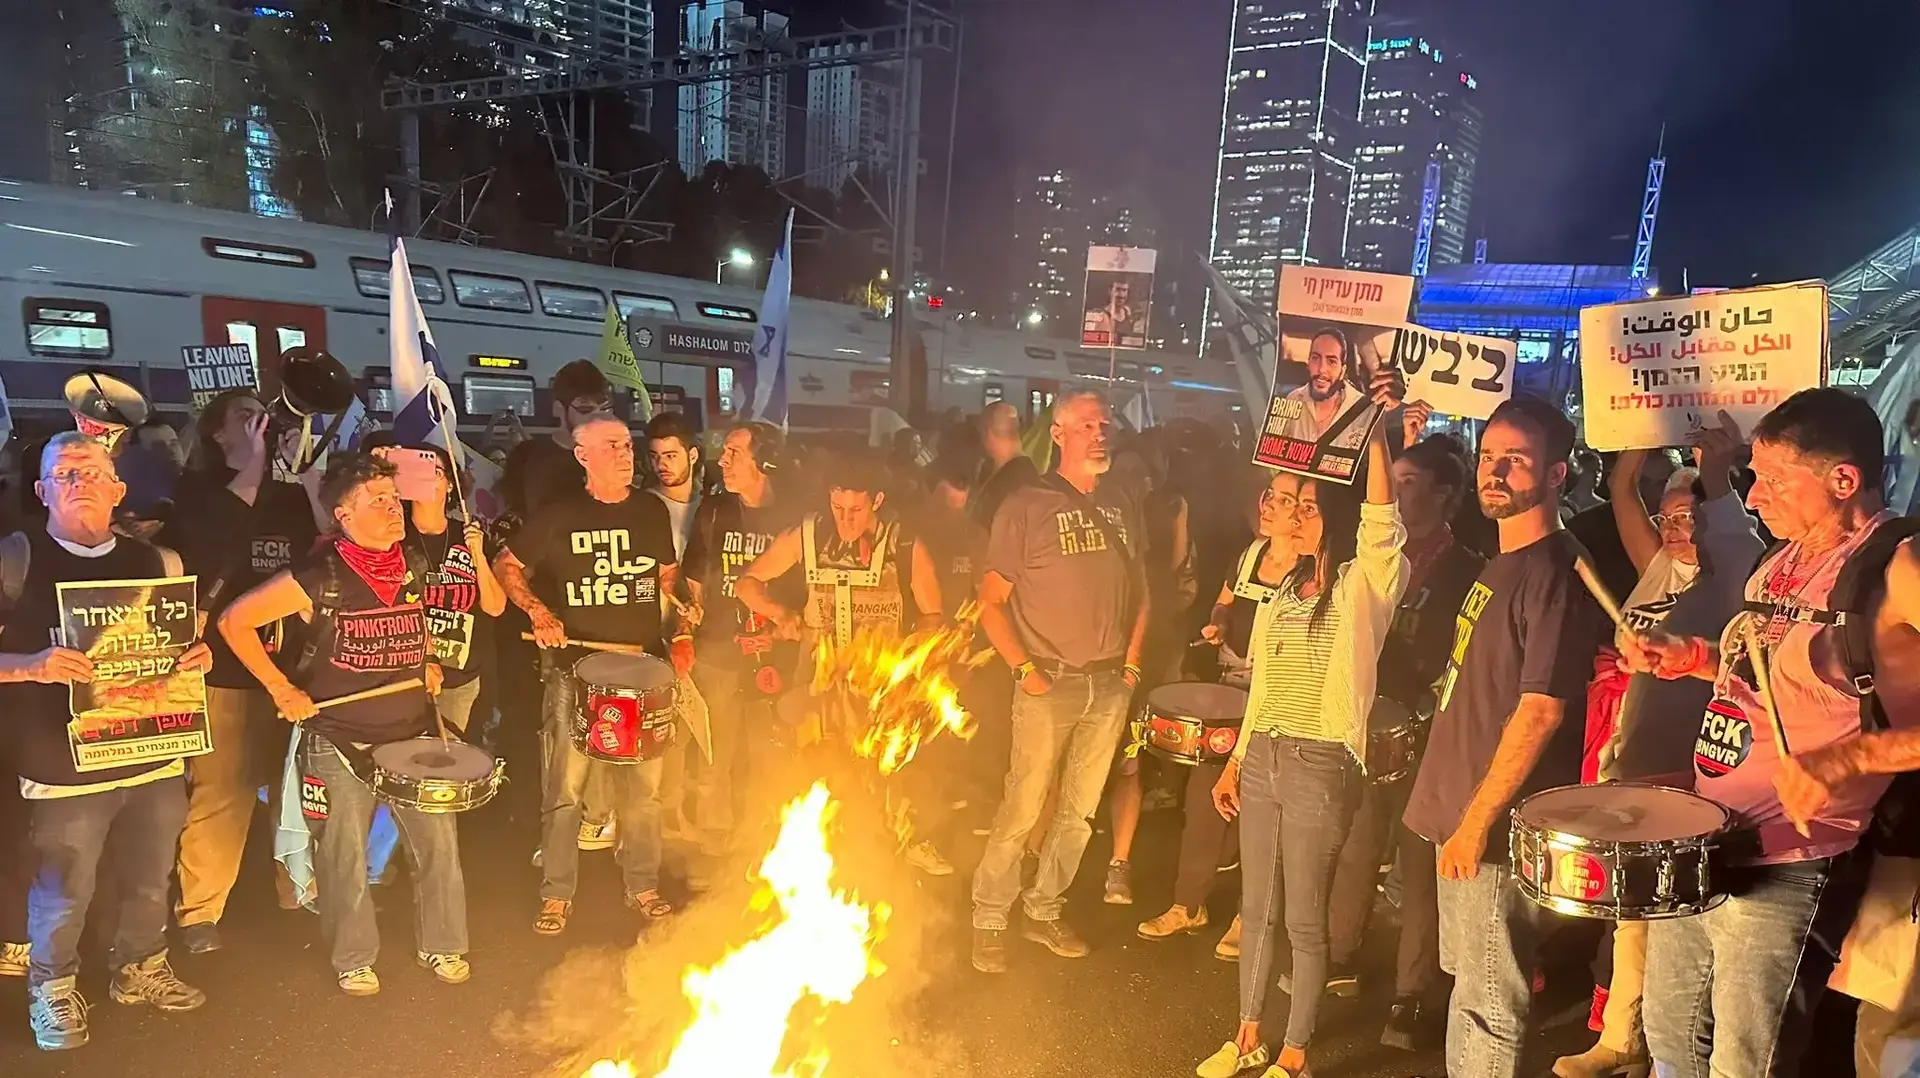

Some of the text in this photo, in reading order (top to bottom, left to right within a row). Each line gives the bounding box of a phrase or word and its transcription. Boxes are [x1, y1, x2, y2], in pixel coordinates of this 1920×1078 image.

[1304, 277, 1383, 303] מתן עדיין חי
[1623, 307, 1772, 337] حان الوقت!
[669, 334, 729, 351] HASHALOM
[1610, 334, 1791, 363] الكل مقابل الكل!
[183, 346, 250, 366] LEAVING
[188, 366, 255, 390] NO ONE
[1633, 363, 1766, 392] הגיע הזמן!
[1271, 397, 1302, 419] BRING
[1610, 391, 1663, 411] כולם!
[1265, 416, 1287, 436] HIM
[1260, 435, 1317, 463] HOME NOW!
[252, 541, 291, 557] FCK
[571, 529, 630, 556] חיים
[566, 577, 628, 606] Life
[71, 597, 187, 626] כל המאחר
[851, 602, 900, 616] BANGKOK
[344, 614, 421, 639] PINKFRONT
[100, 626, 171, 654] לפדות
[343, 638, 386, 654] الوردية
[83, 713, 194, 740] שפך דמם
[1700, 710, 1748, 748] FCK
[84, 739, 198, 760] אין מנצחים במלחמה
[1696, 738, 1739, 767] BNGVR
[303, 783, 328, 802] CK
